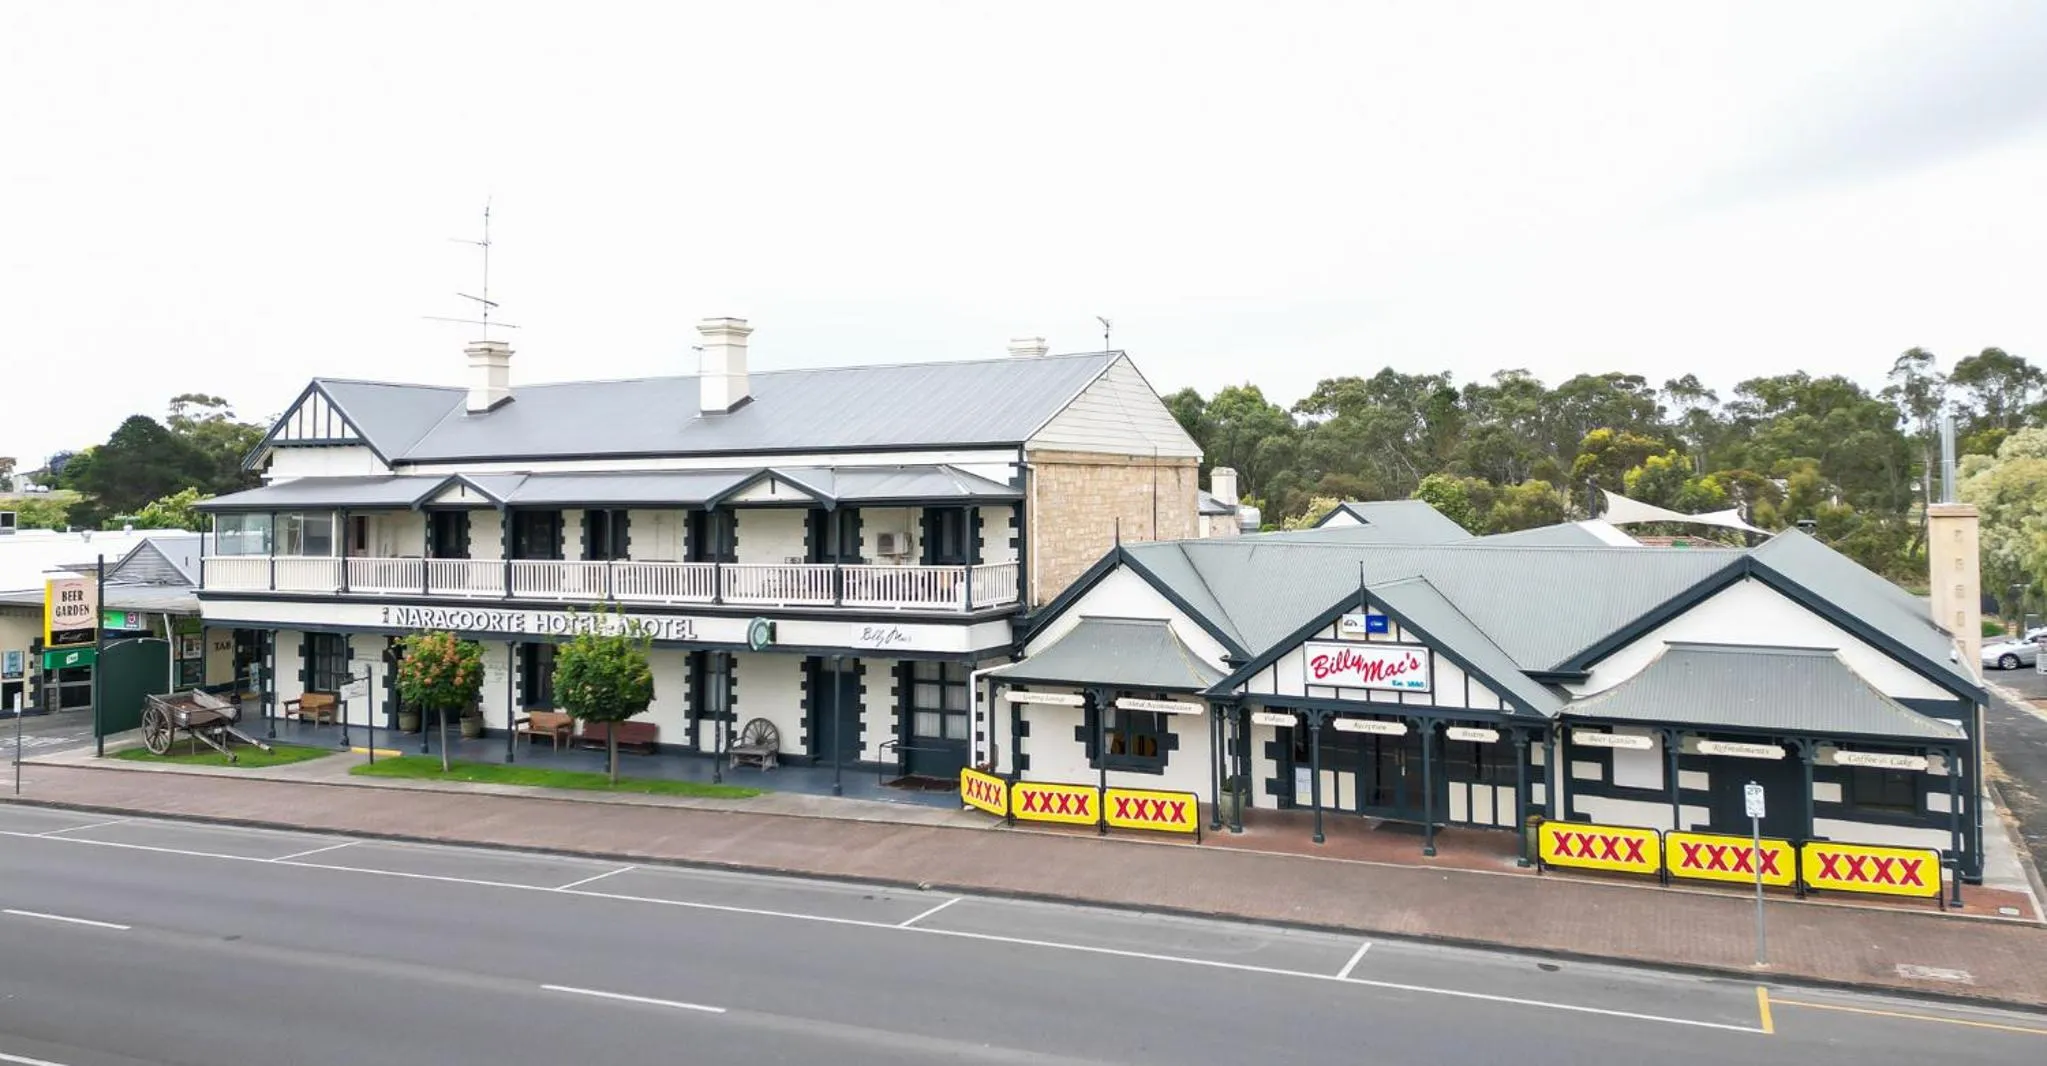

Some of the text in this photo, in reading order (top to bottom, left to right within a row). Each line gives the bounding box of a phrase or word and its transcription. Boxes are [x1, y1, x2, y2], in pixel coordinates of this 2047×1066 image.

[62, 590, 84, 602] BEER
[56, 604, 90, 617] GARDEN
[394, 607, 526, 632] NARACOORTE
[1310, 648, 1420, 683] Billy Mac's
[1848, 754, 1877, 763] Coffee
[965, 776, 1003, 808] XXXX
[1021, 790, 1090, 816] XXXX
[1114, 797, 1187, 824] XXXX
[1552, 831, 1646, 864] XXXX
[1679, 842, 1781, 876] XXXX
[1816, 852, 1925, 887] XXXX
